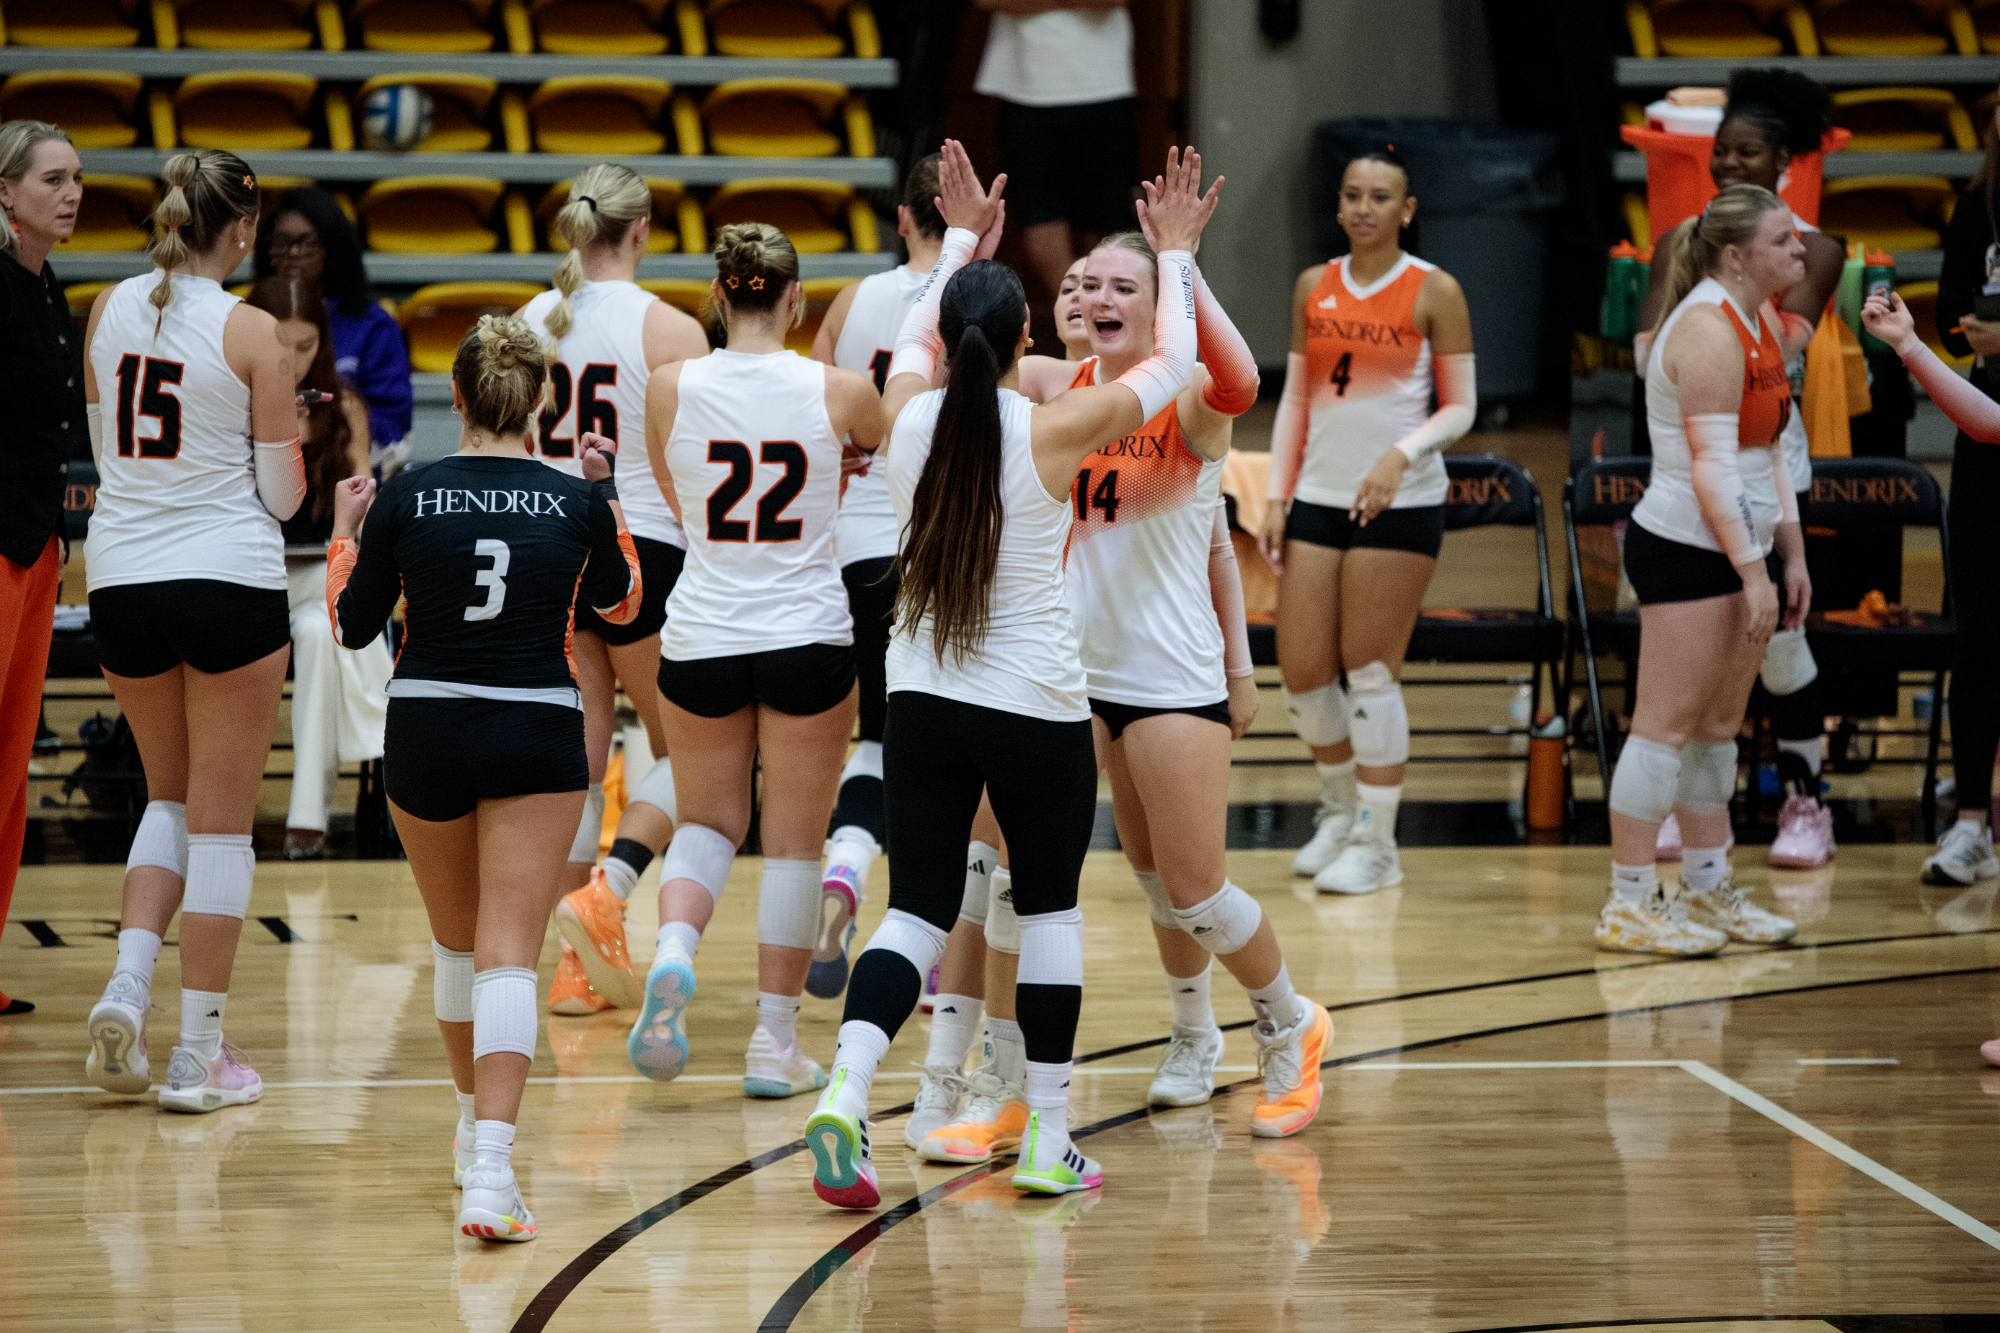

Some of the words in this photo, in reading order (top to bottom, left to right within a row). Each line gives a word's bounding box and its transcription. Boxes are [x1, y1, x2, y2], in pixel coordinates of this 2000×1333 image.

[1179, 265, 1196, 321] WARRIORS
[1330, 352, 1352, 397] 4
[115, 352, 185, 460] 15
[537, 361, 619, 459] 26
[1096, 435, 1167, 460] DRIX
[414, 488, 567, 518] HENDRIX
[706, 440, 809, 543] 22
[1077, 468, 1121, 523] 14
[1808, 477, 1919, 506] ENDRIX
[463, 538, 511, 622] 3
